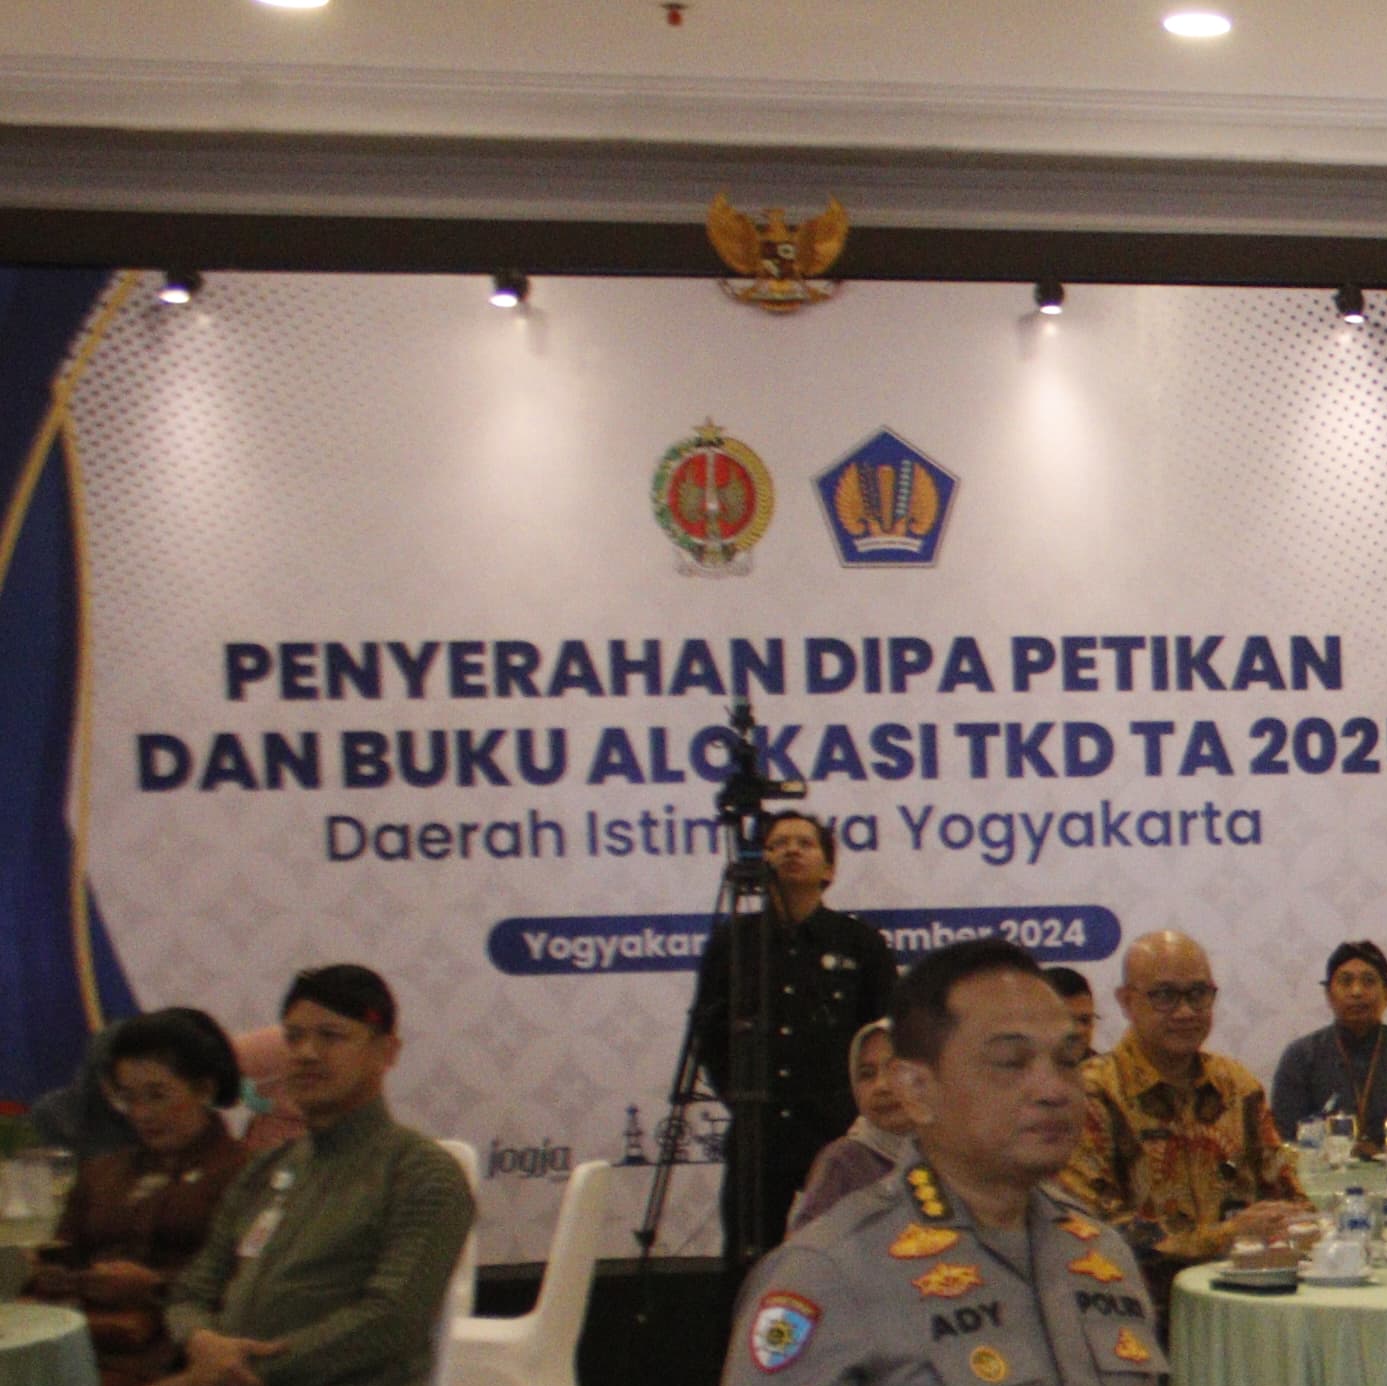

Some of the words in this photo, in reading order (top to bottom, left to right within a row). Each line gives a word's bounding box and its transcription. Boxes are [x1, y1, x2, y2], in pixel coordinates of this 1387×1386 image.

[223, 638, 786, 701] PENYERAHAN
[804, 636, 994, 693] DIPA
[1011, 635, 1343, 693] PETIKAN
[136, 730, 325, 793] DAN
[342, 727, 568, 789] BUKU
[585, 722, 939, 785] ALOKASI
[955, 722, 1115, 781] TKD
[1130, 720, 1234, 778] TA
[325, 808, 566, 863] Daerah
[897, 800, 1262, 866] Yogyakarta
[521, 927, 710, 969] Yogyakar
[1000, 918, 1086, 949] 2024
[484, 1135, 571, 1181] jogja
[930, 1301, 1003, 1342] ADY
